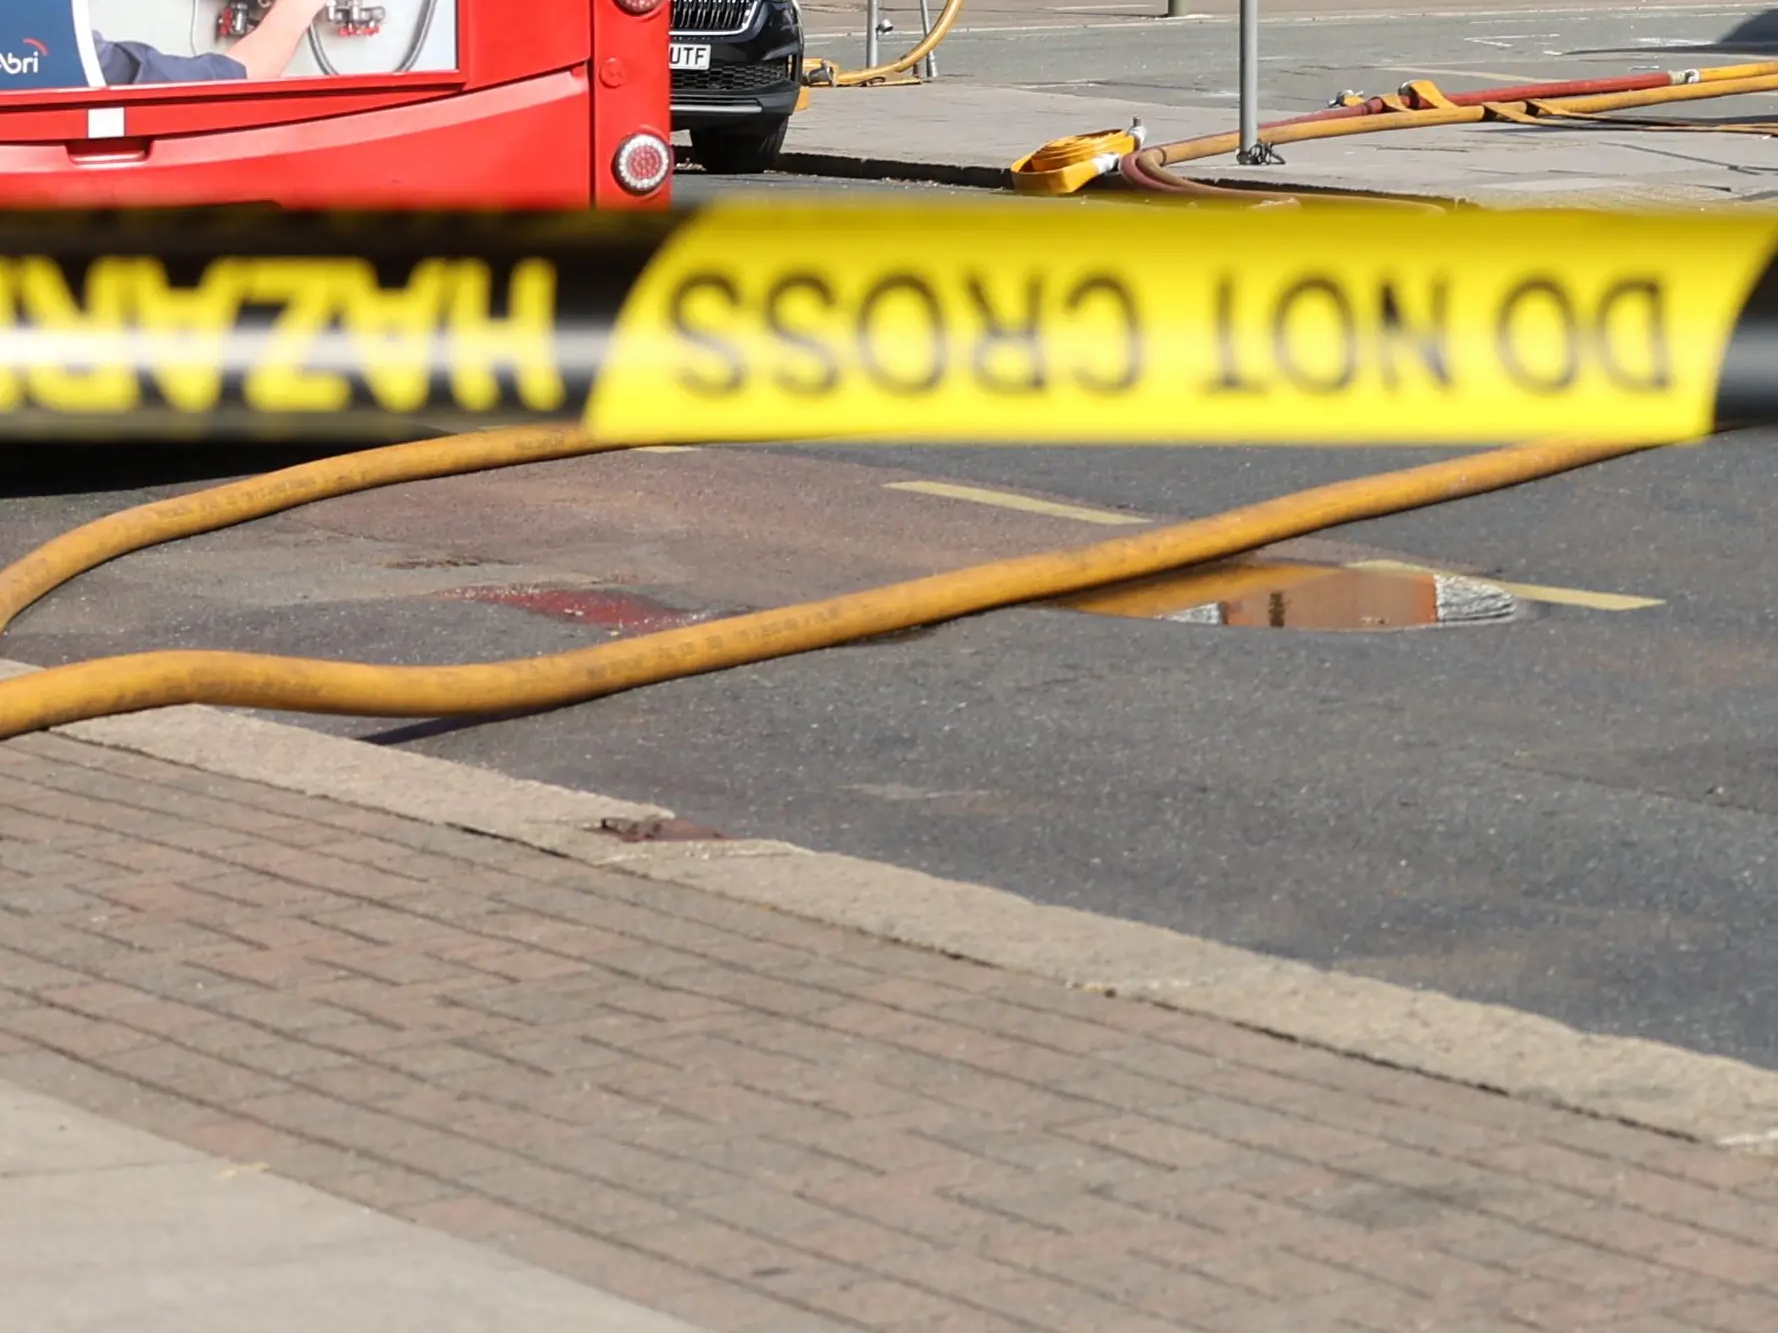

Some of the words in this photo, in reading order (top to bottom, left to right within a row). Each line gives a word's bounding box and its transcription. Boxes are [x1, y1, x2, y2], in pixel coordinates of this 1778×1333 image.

[669, 47, 706, 65] UTF
[0, 253, 566, 413] HAZAR
[666, 265, 1145, 399] CROSS
[1199, 270, 1454, 396] NOT
[1495, 275, 1674, 395] DO
